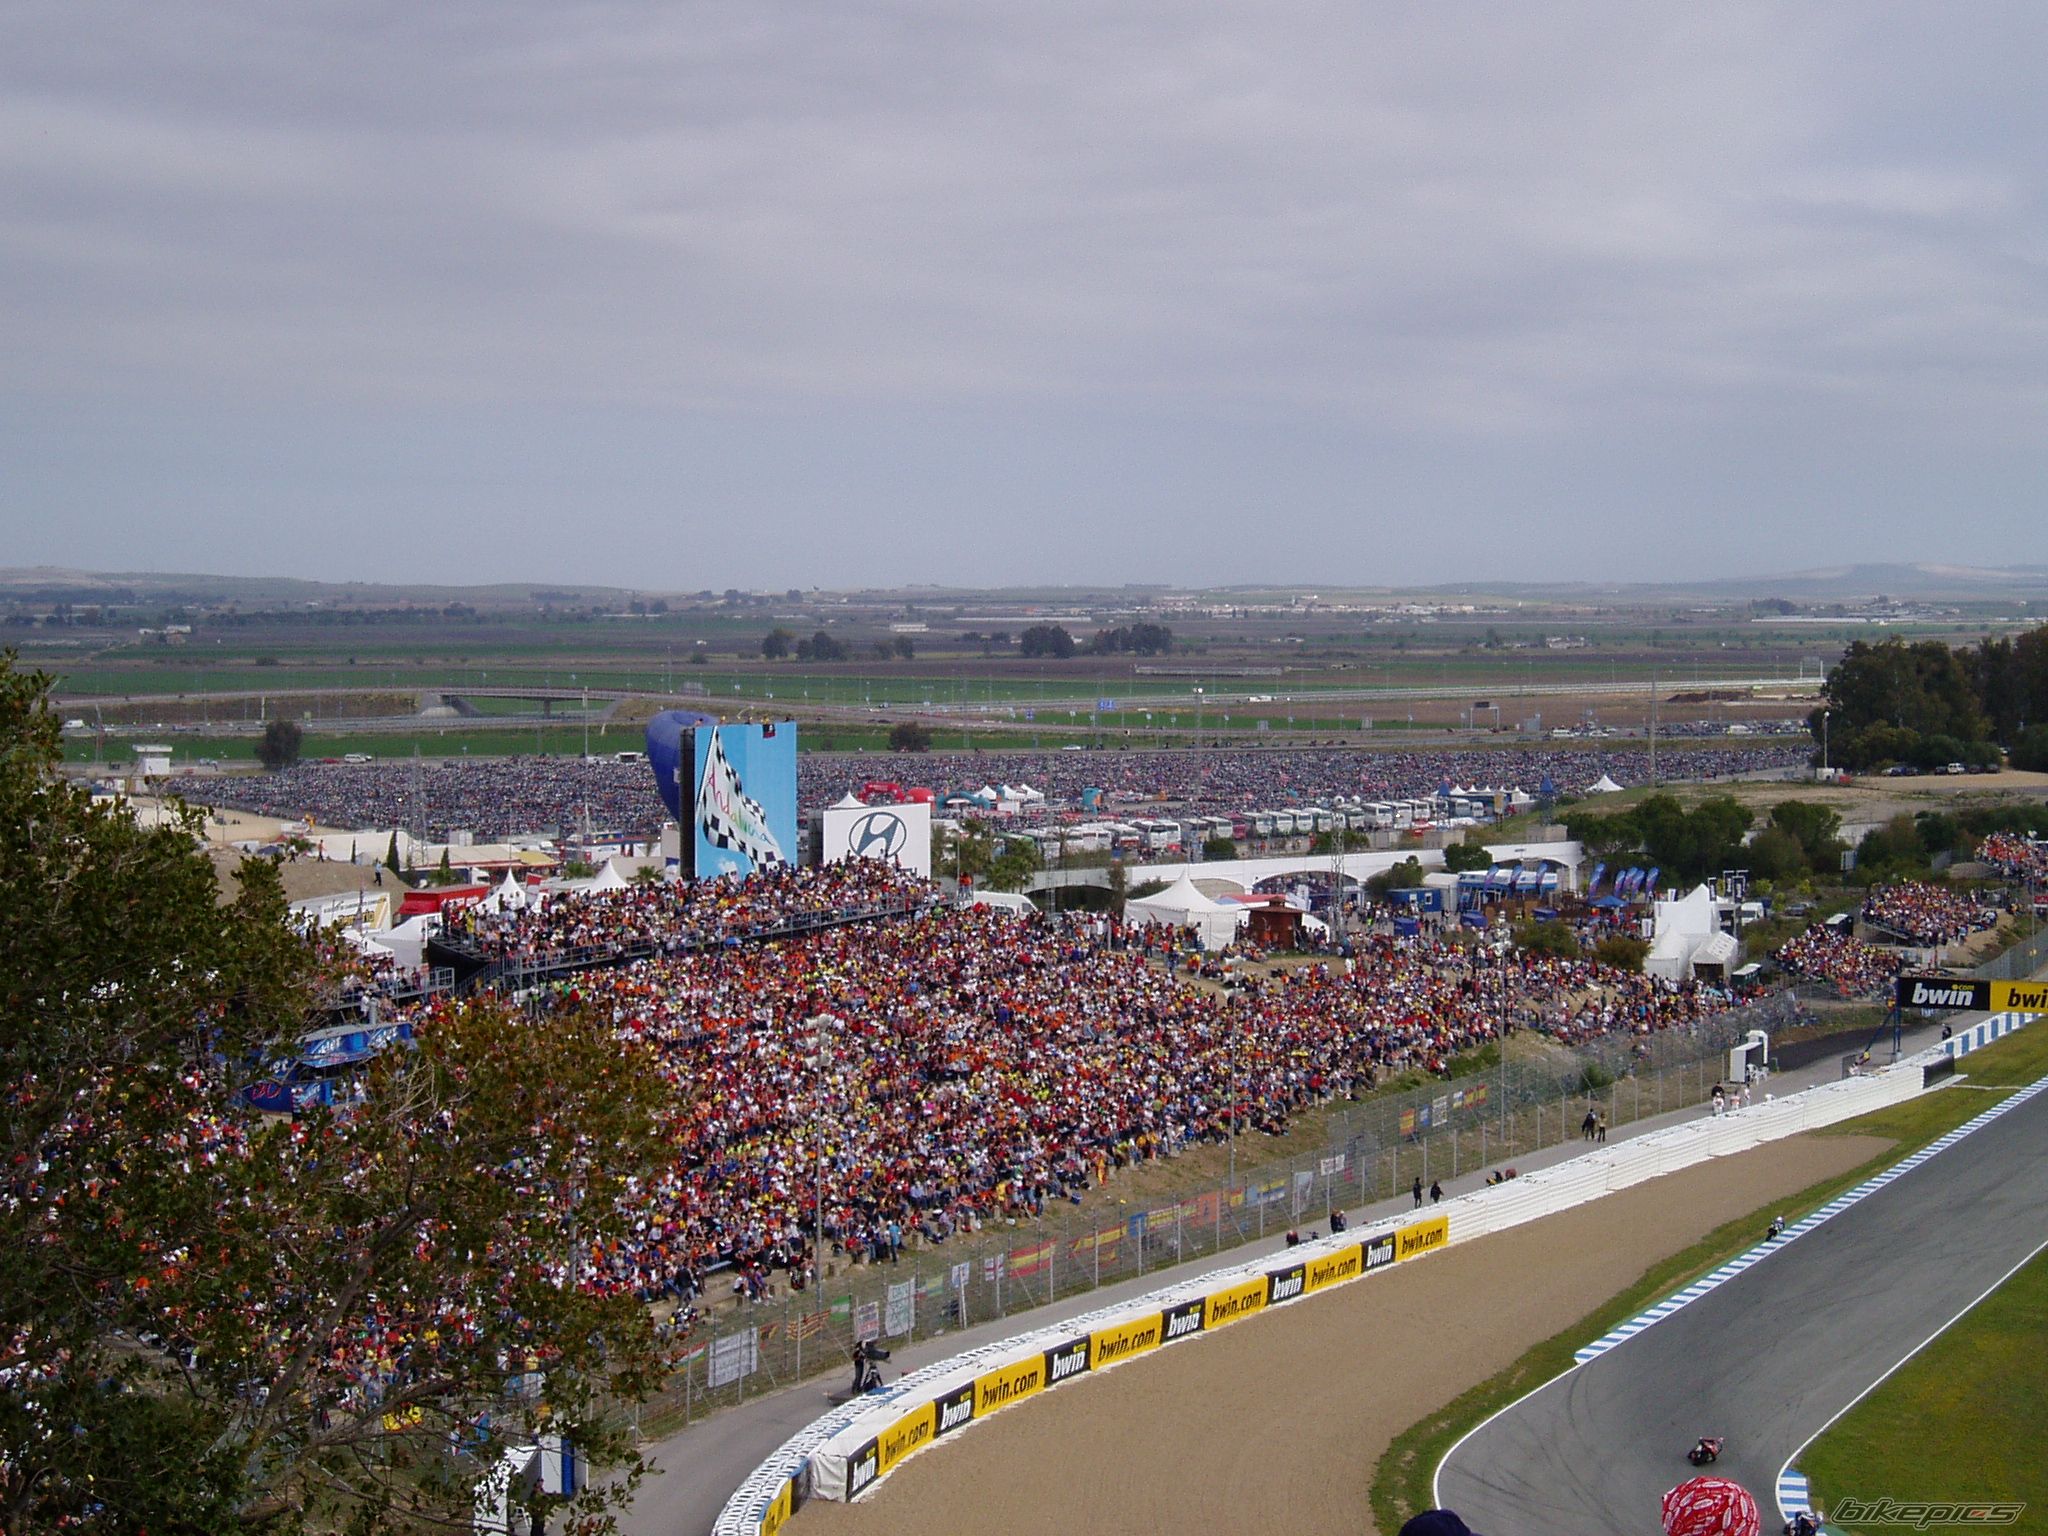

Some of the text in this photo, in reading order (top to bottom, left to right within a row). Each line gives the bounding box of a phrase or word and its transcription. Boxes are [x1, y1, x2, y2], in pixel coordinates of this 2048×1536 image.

[1912, 982, 1973, 1006] bwin
[1366, 1244, 1393, 1267] bwin
[1401, 1228, 1443, 1254] bwin.com
[1311, 1258, 1356, 1287] bwin.com
[1273, 1275, 1303, 1300] bwin
[1211, 1290, 1261, 1322] bwin.com
[1167, 1312, 1200, 1337] bwin
[1098, 1327, 1155, 1362] bwin.com
[1052, 1351, 1086, 1380] bwin
[982, 1370, 1038, 1409] bwin.com
[940, 1397, 972, 1430] bwin
[884, 1419, 929, 1464] bwin.com
[852, 1456, 876, 1491] bwin
